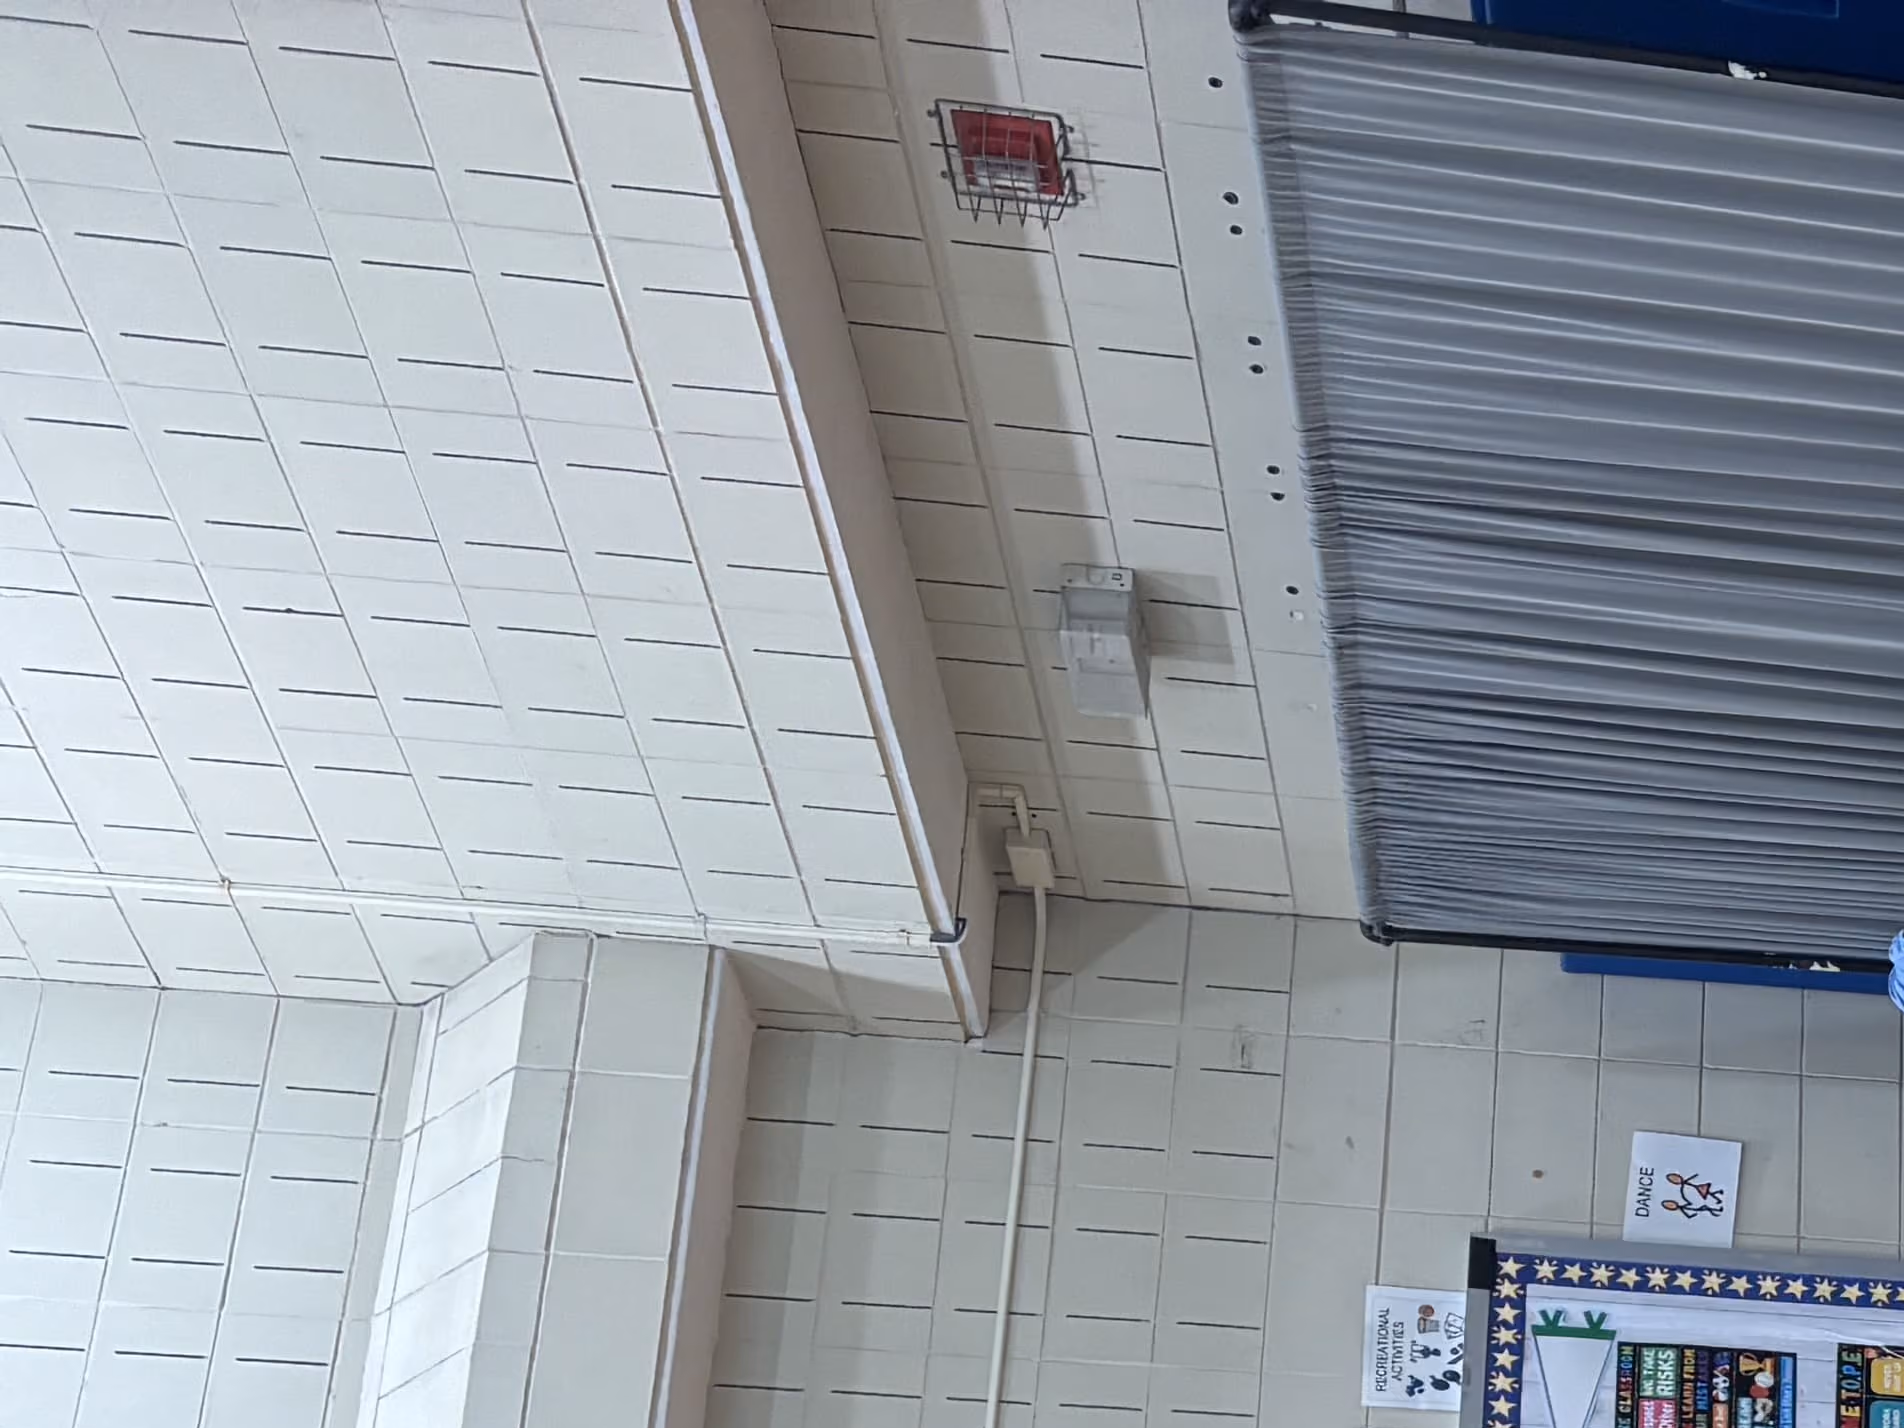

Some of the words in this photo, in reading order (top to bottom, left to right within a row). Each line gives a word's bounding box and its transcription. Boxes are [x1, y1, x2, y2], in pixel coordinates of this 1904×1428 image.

[1635, 1166, 1654, 1217] DANCE
[1375, 1307, 1390, 1392] RECREATIONAL
[1391, 1321, 1404, 1381] ACTIVITIES
[1642, 1348, 1655, 1375] TAKE
[1683, 1348, 1695, 1379] FROM
[1618, 1346, 1634, 1413] CLASSROOM
[1640, 1379, 1654, 1396] WE
[1658, 1350, 1674, 1396] RISKS
[1682, 1383, 1694, 1418] LEARN
